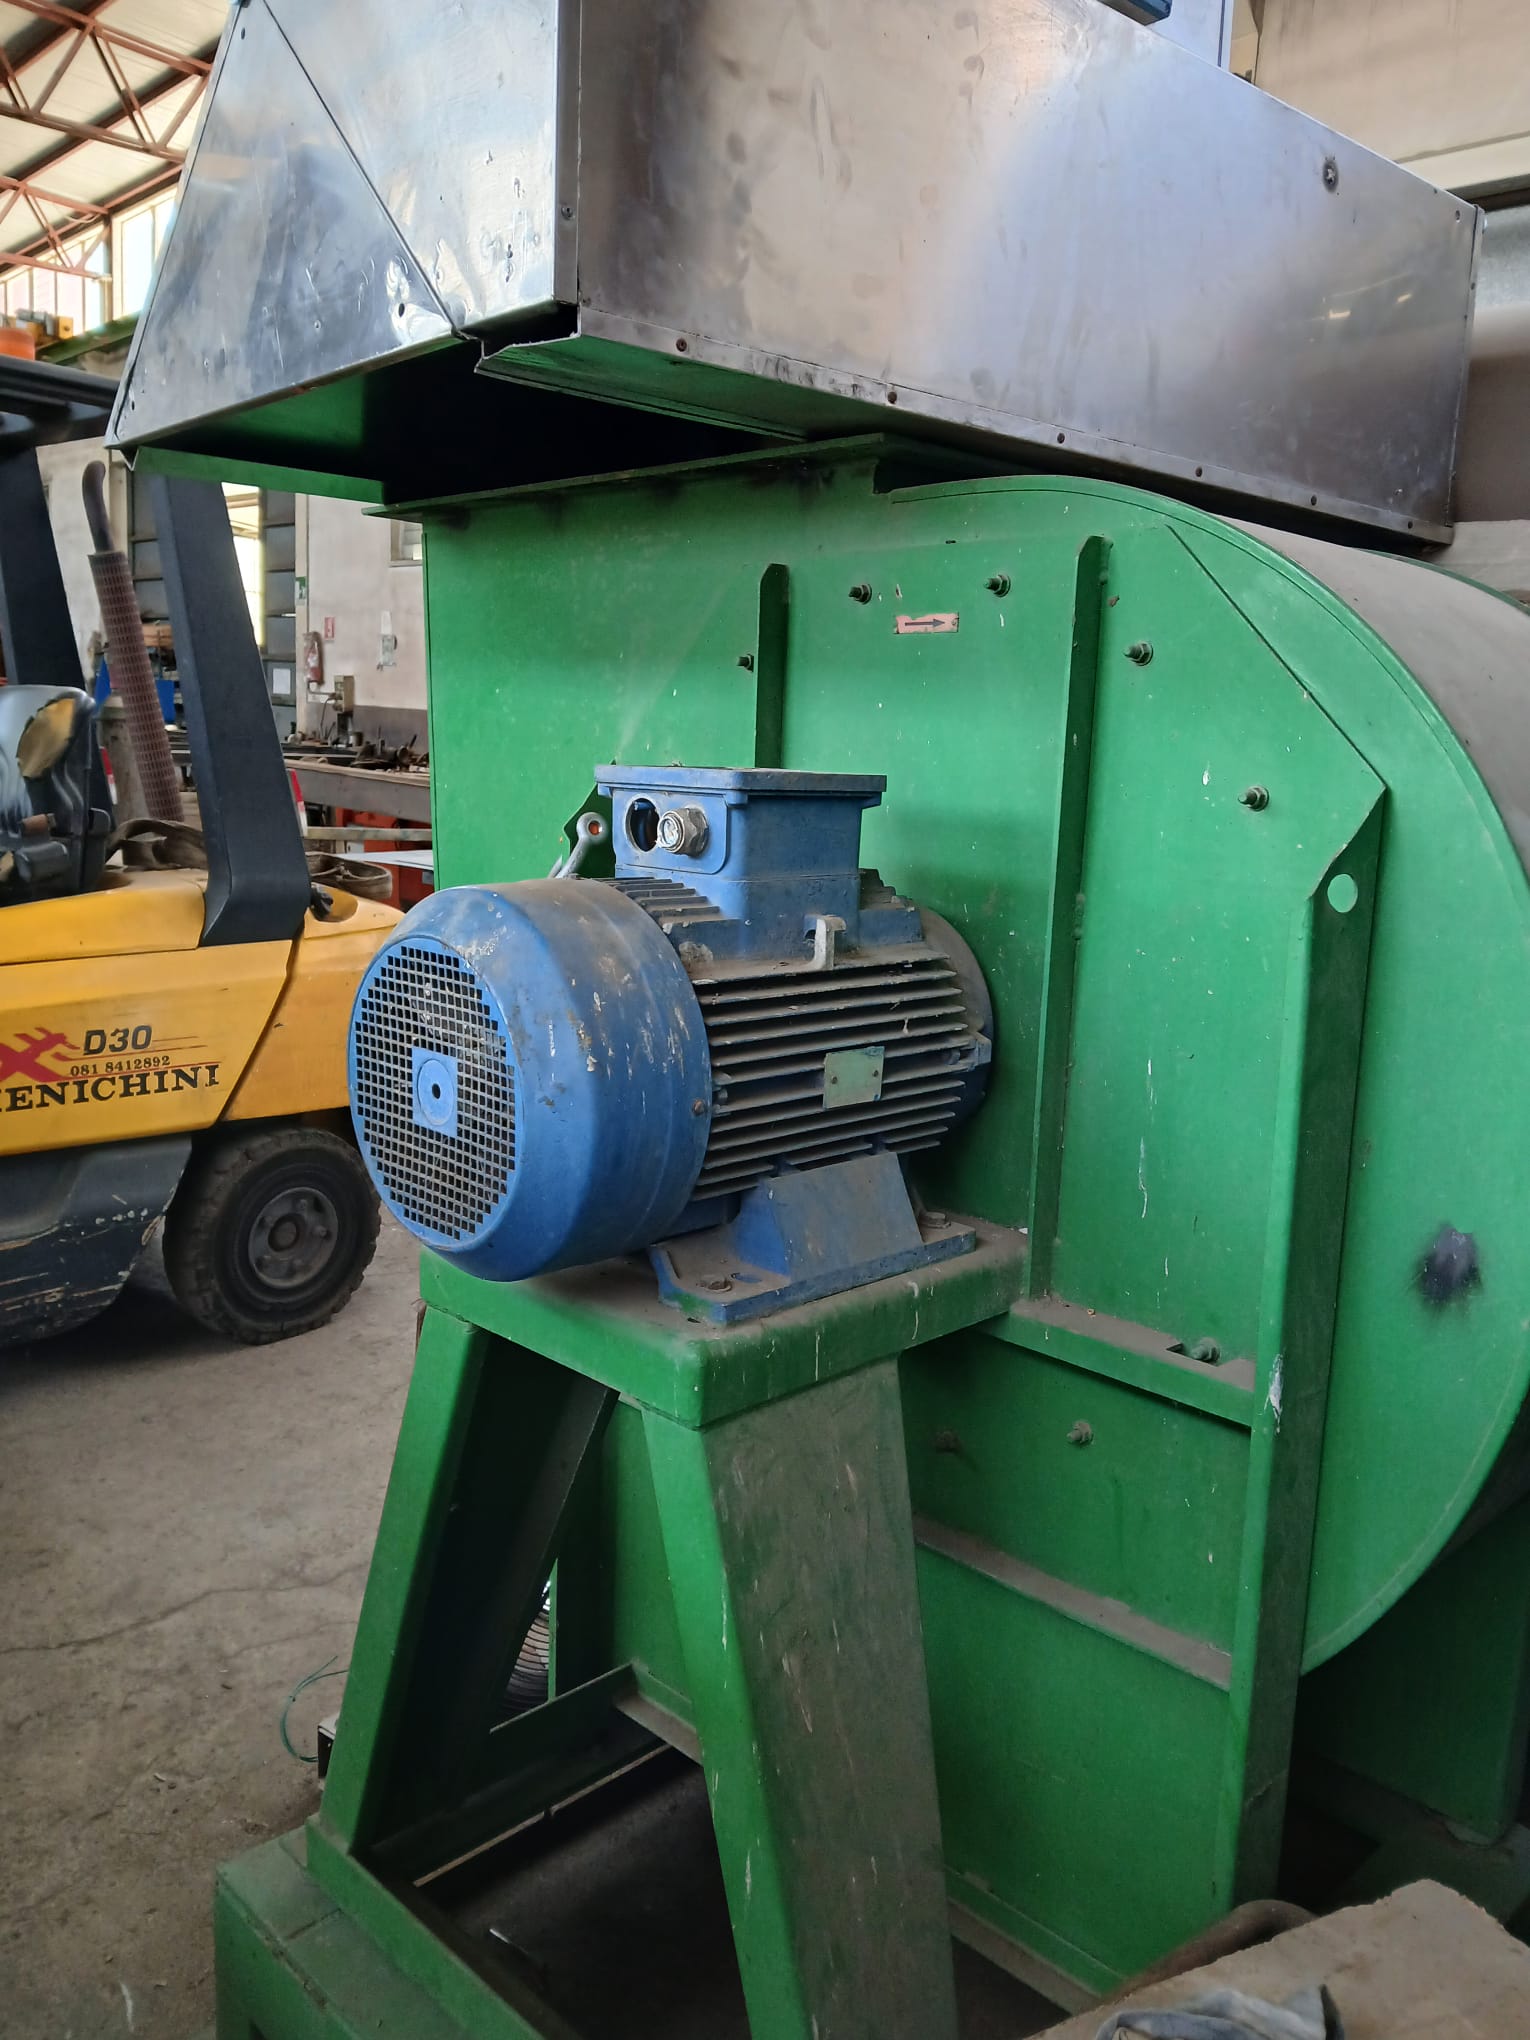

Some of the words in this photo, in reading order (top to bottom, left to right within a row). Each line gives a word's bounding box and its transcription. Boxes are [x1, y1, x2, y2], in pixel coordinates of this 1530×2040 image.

[83, 1025, 152, 1055] D30
[70, 1064, 98, 1077] 081
[105, 1055, 171, 1073] 8412892
[0, 1064, 220, 1113] ENICHINI
